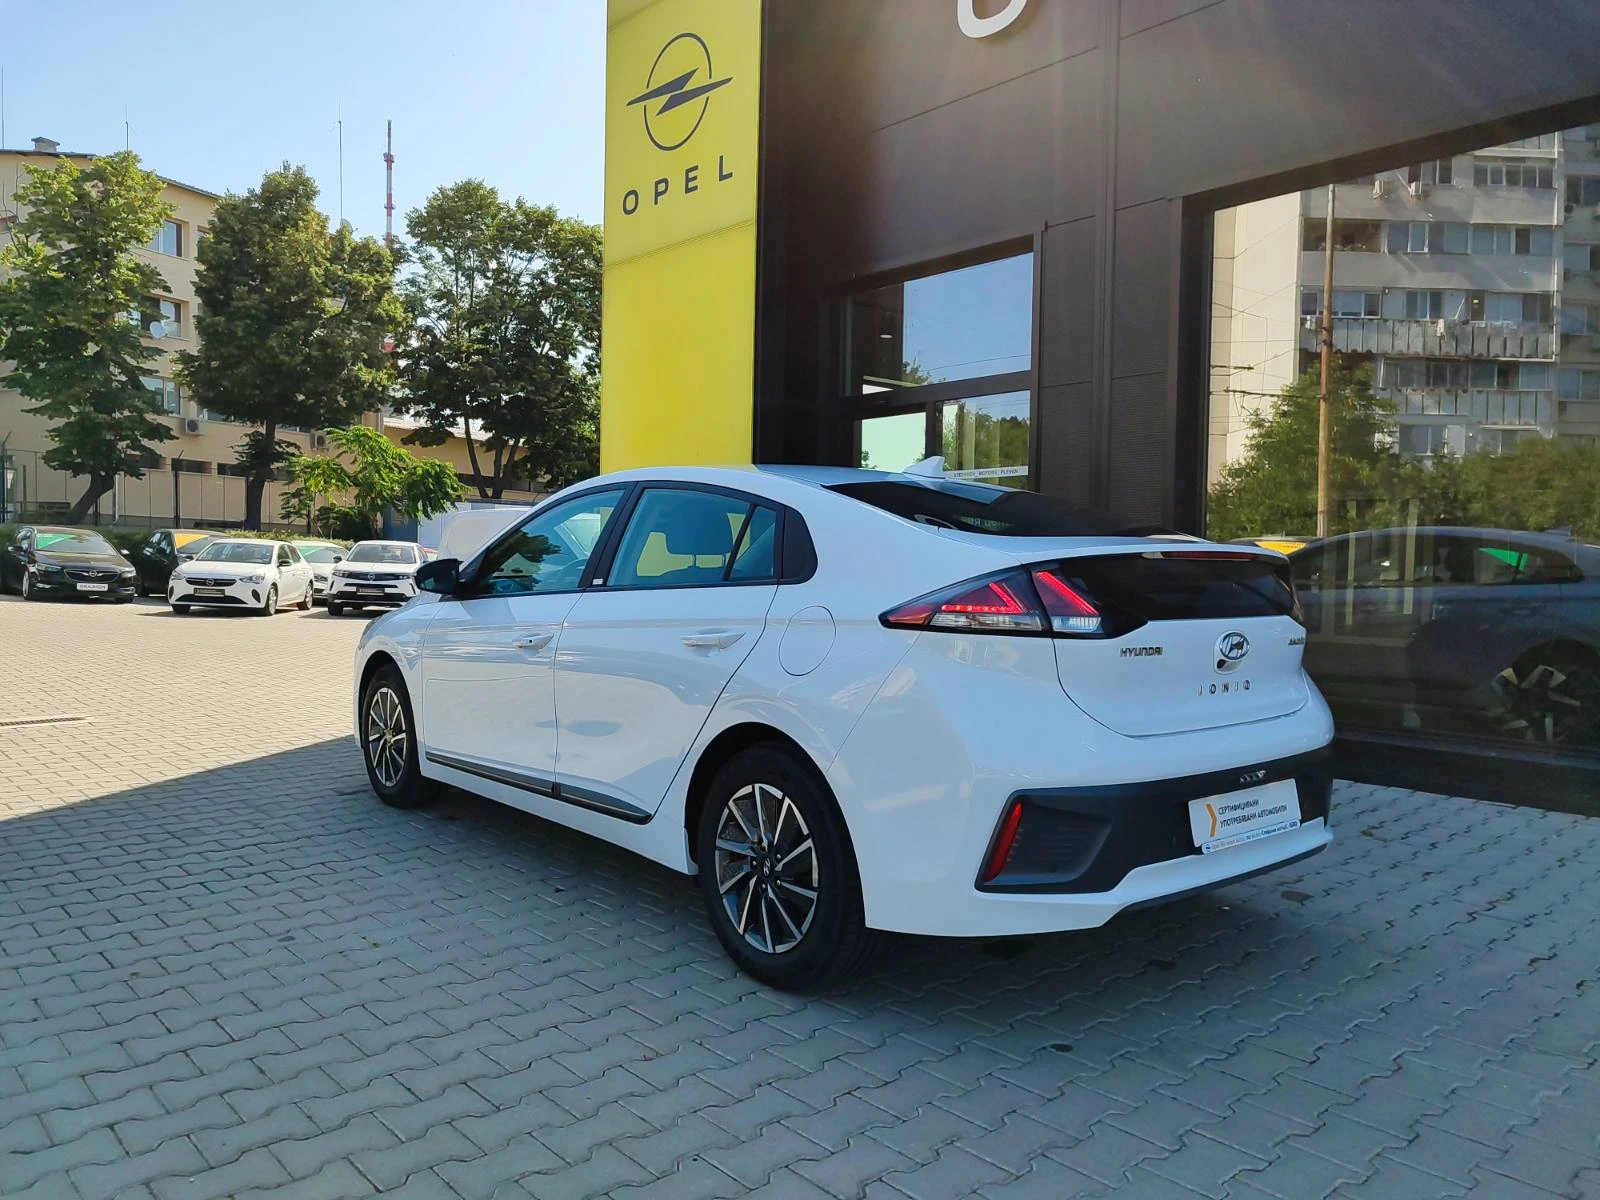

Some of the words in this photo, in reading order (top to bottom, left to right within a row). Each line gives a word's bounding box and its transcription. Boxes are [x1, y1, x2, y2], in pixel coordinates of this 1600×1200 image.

[622, 155, 733, 216] OPEL
[1120, 646, 1163, 657] HYUNDAI
[1197, 680, 1251, 696] IONIQ
[1218, 799, 1260, 814] СЕРТИФИЦИРАНИ
[1220, 813, 1257, 828] УПОТРЕБЯВАНИ
[1257, 804, 1288, 818] АВТОМОБИЛИ
